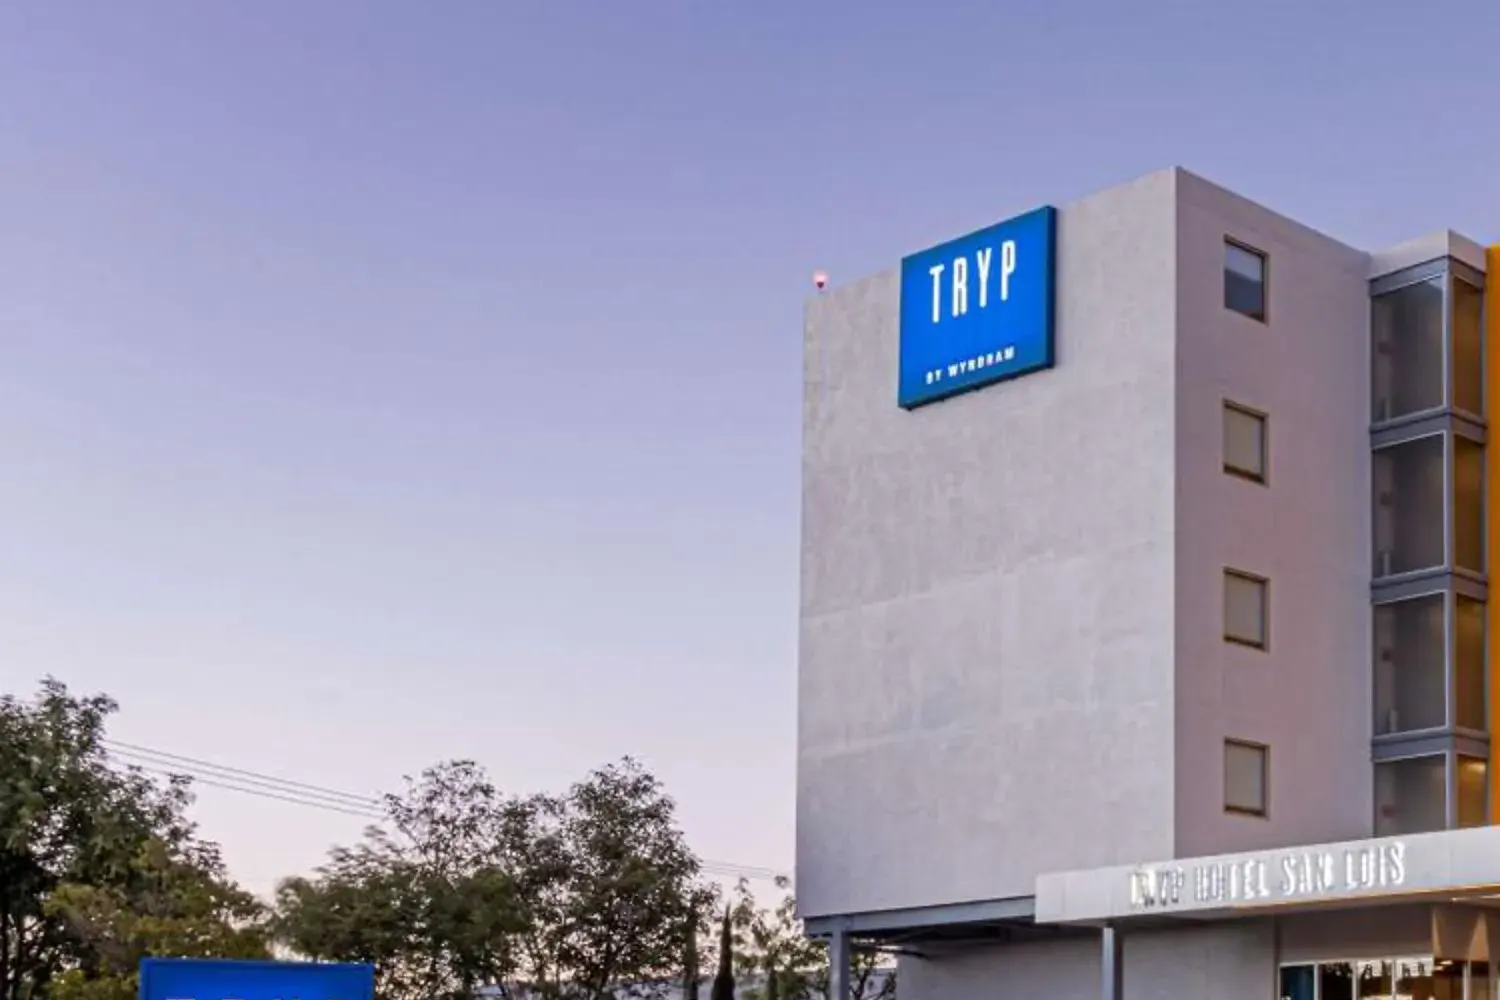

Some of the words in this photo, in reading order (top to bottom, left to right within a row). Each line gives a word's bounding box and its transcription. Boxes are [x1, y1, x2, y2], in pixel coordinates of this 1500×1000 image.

[929, 240, 1016, 324] TRYP
[926, 369, 942, 385] BY
[948, 346, 1015, 377] WYNDHAM
[1194, 859, 1270, 901] HOTEL
[1281, 851, 1334, 895] SAN
[1344, 841, 1405, 890] LUIS
